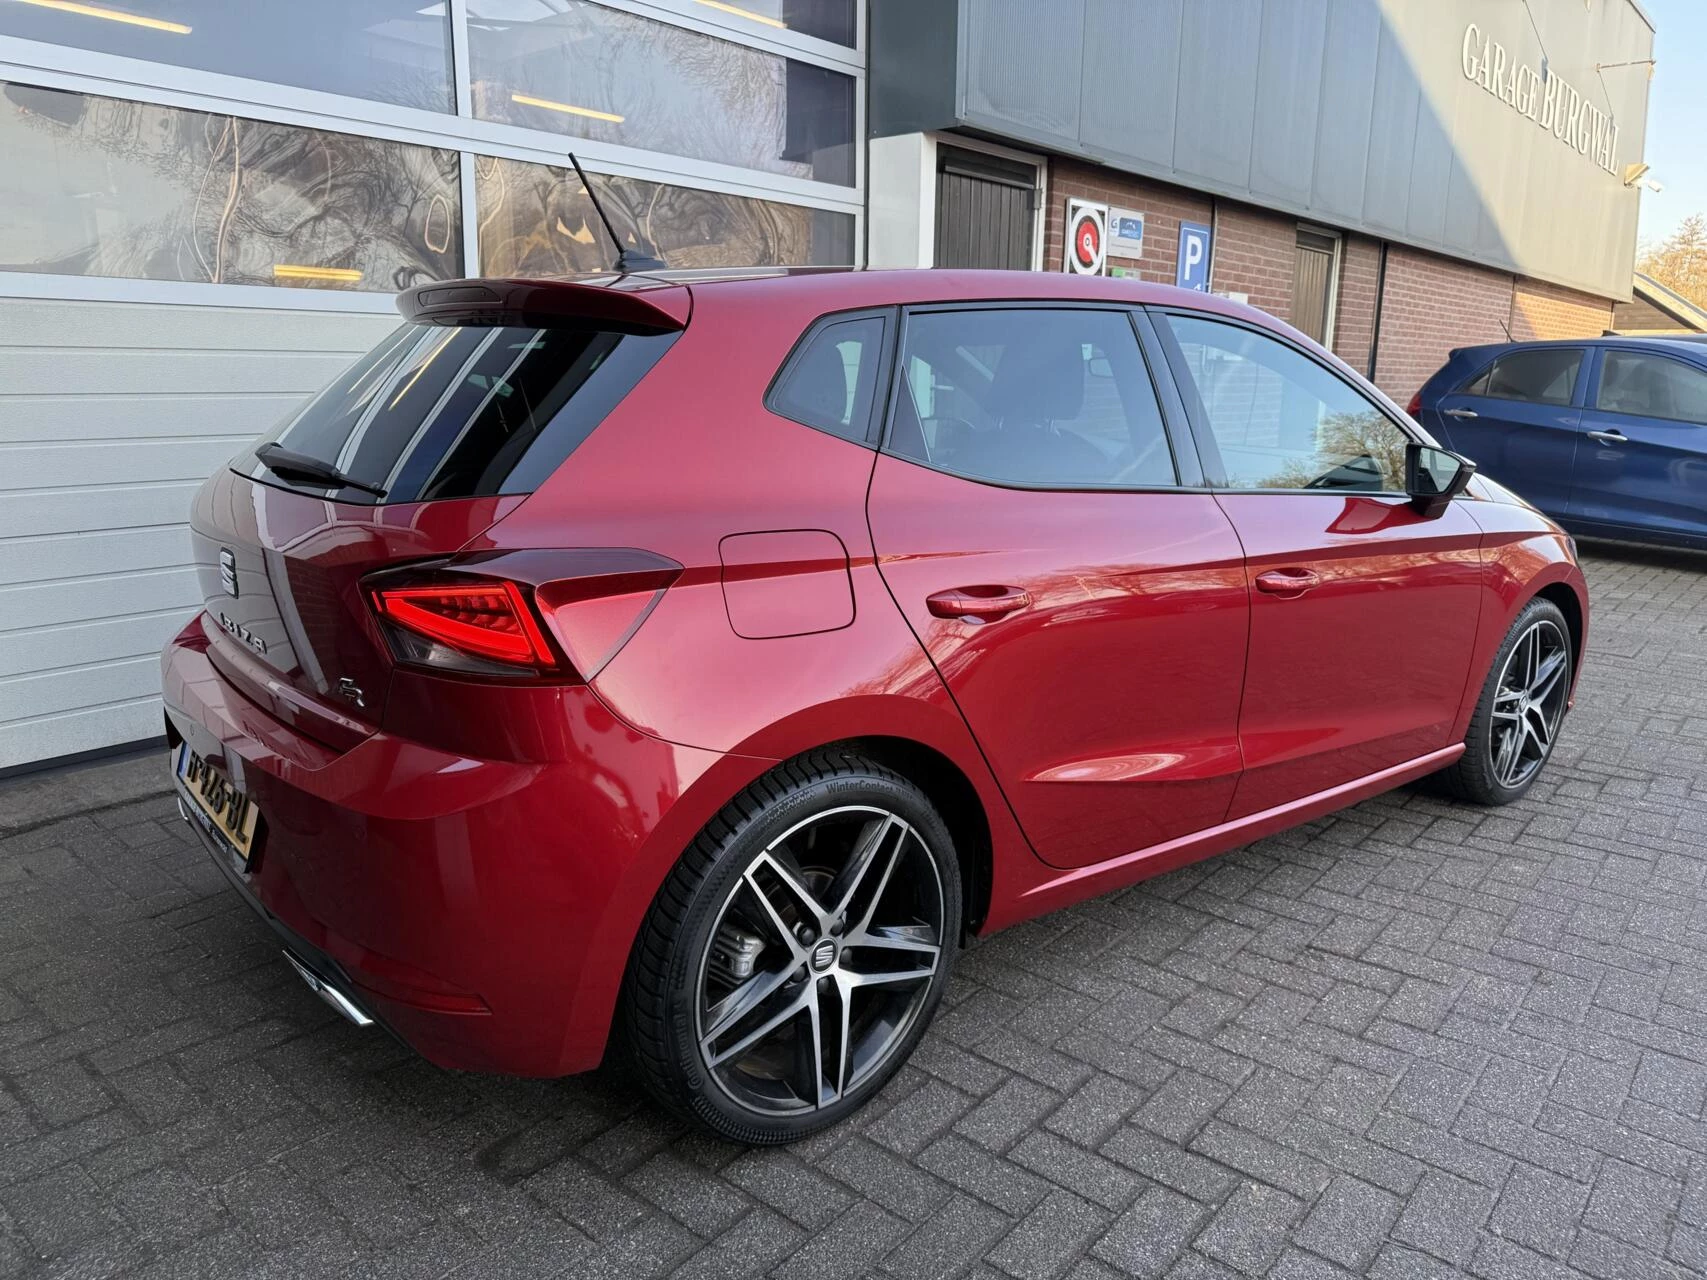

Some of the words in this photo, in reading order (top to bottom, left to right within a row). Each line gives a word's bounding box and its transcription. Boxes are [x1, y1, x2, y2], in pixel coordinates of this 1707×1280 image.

[1462, 24, 1541, 123] GARAGE
[1540, 66, 1620, 176] BURGWAL
[1184, 235, 1203, 281] P
[825, 780, 893, 795] WinterContact
